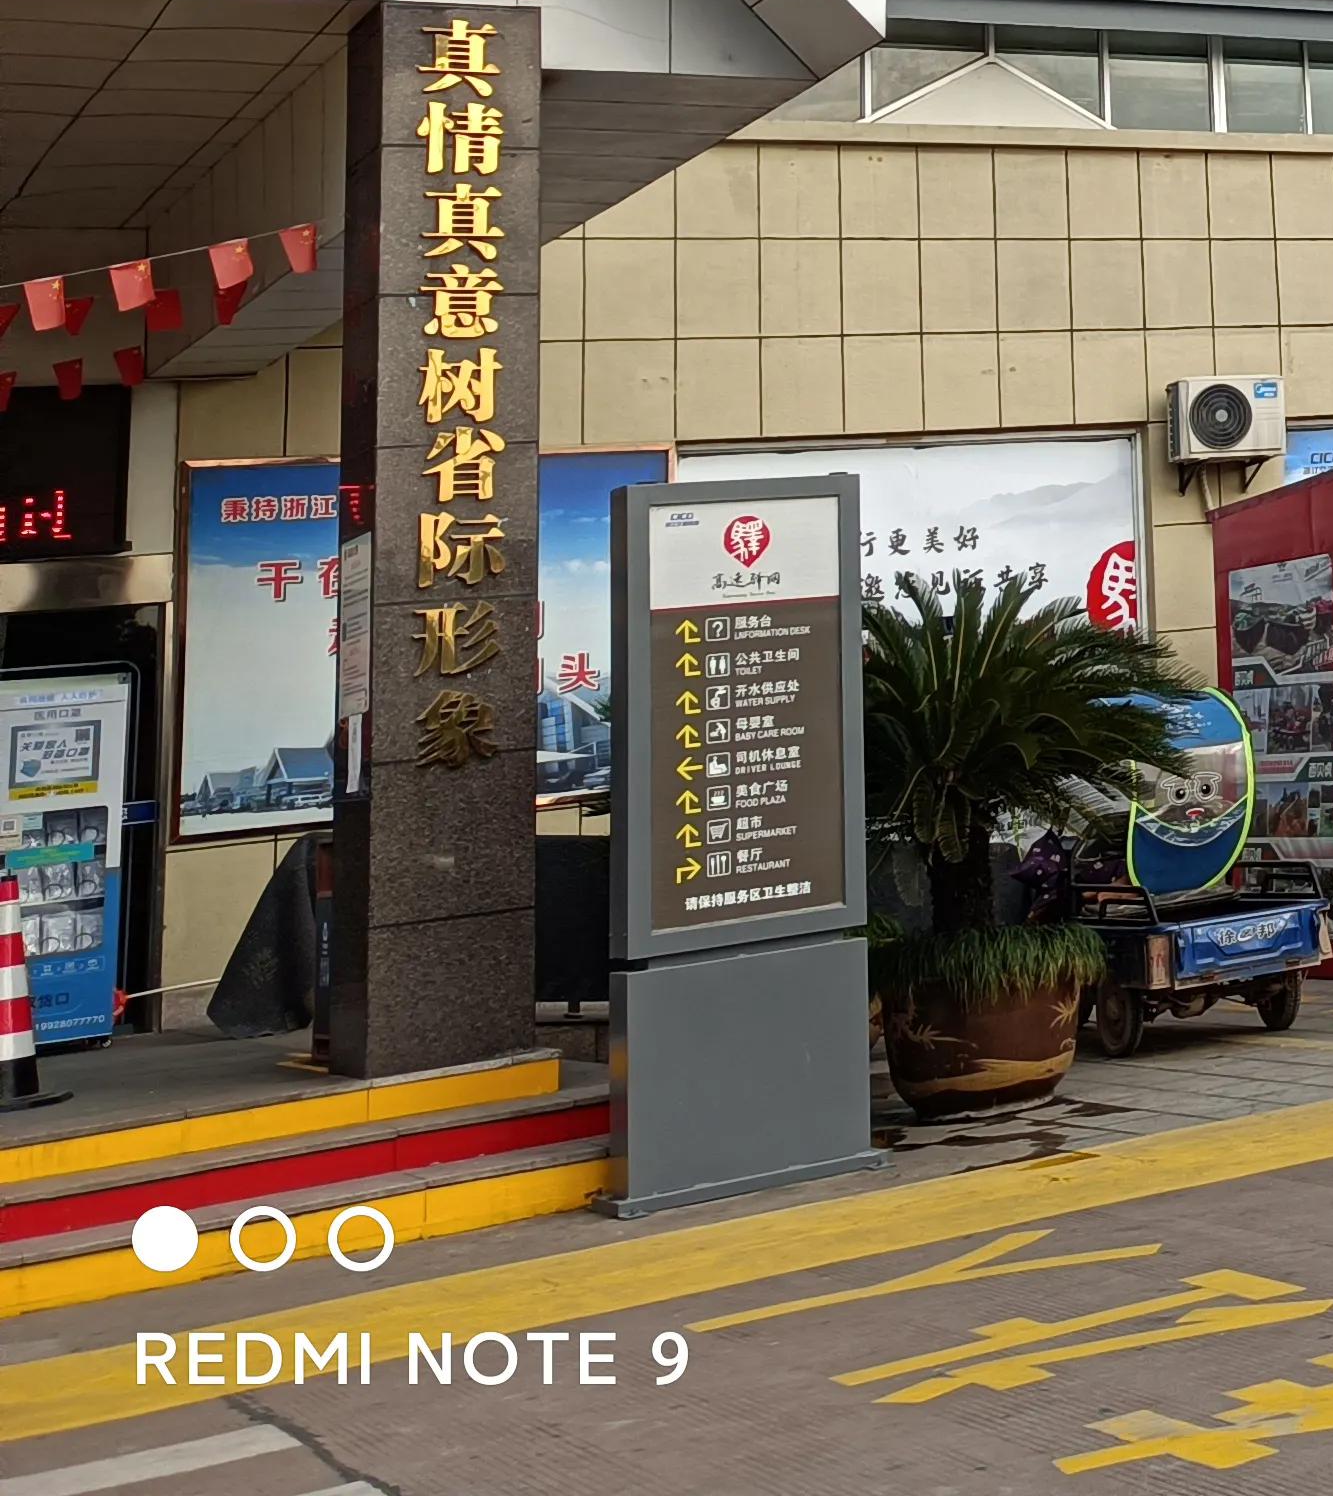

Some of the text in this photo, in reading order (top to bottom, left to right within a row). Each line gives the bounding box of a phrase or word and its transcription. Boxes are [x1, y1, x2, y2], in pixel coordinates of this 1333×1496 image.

[415, 18, 507, 769] 真情真意树省际形象
[221, 495, 338, 523] 秉持浙江
[734, 614, 773, 630] 服务台
[735, 647, 801, 666] 公共卫生间
[556, 651, 600, 695] 头
[735, 665, 763, 677] TOILET
[735, 679, 801, 698] 开水供应处
[735, 694, 796, 708] WATER SUPPLY
[735, 714, 775, 731] 母婴室
[756, 728, 779, 740] CARE
[780, 726, 805, 736] ROOM
[736, 745, 801, 764] 司机休息室
[734, 760, 802, 775] DRIVER LOUNGE
[735, 779, 789, 798] 美食广场
[735, 794, 787, 809] FOOD PLAZA
[736, 815, 763, 831] 超市
[735, 825, 798, 842] SUPERMARKET
[736, 847, 763, 864] 餐厅
[735, 858, 791, 875] RESTAURANT
[684, 880, 812, 911] 请保持服务区卫生整洁
